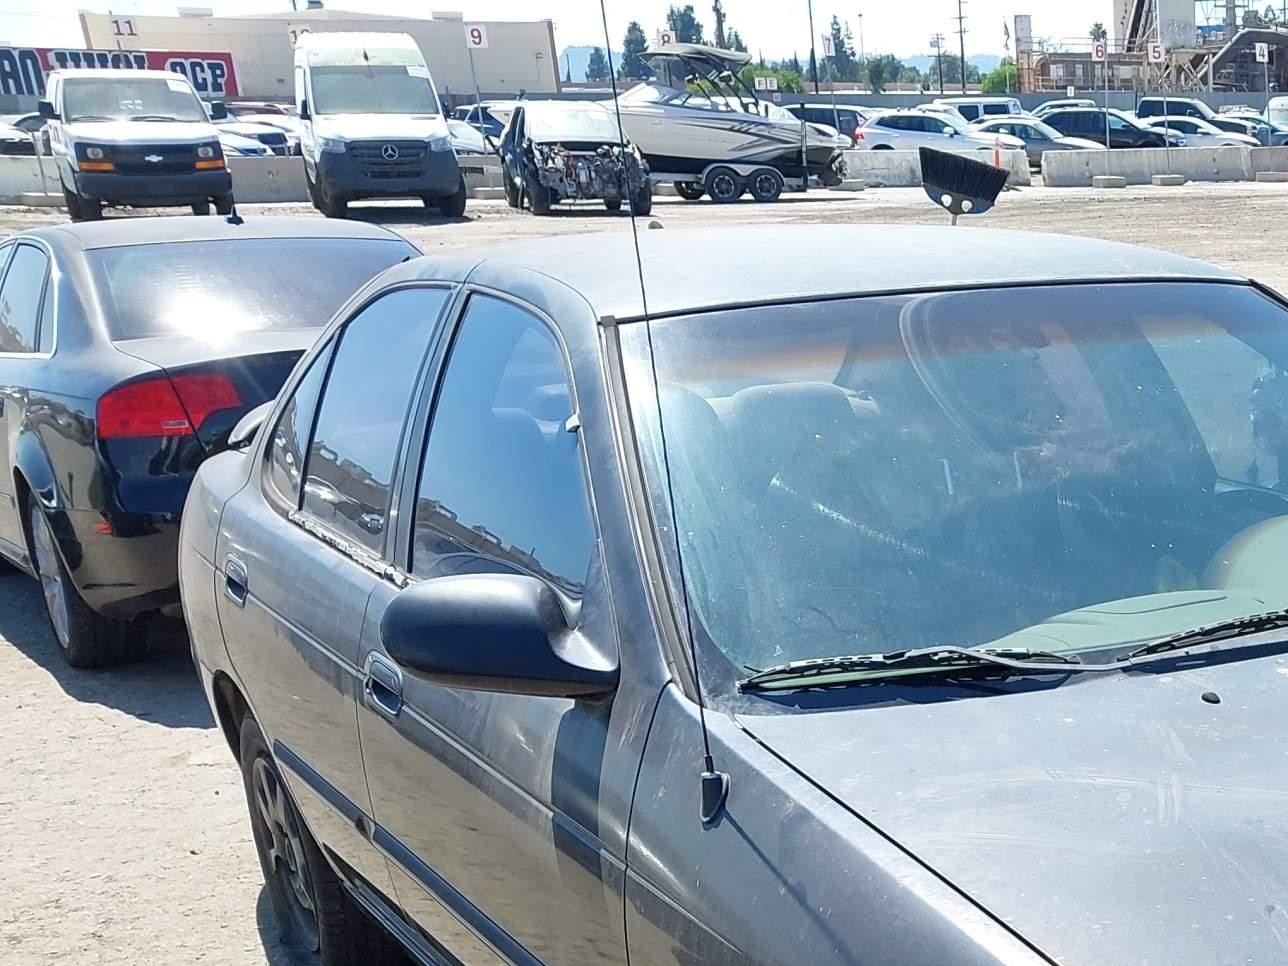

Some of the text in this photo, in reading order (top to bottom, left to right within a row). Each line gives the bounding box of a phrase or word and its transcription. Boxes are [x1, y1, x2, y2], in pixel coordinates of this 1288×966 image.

[112, 20, 138, 37] 11
[470, 28, 482, 45] 9
[1095, 44, 1104, 59] 6
[1152, 44, 1161, 59] 5
[1258, 45, 1266, 60] 4
